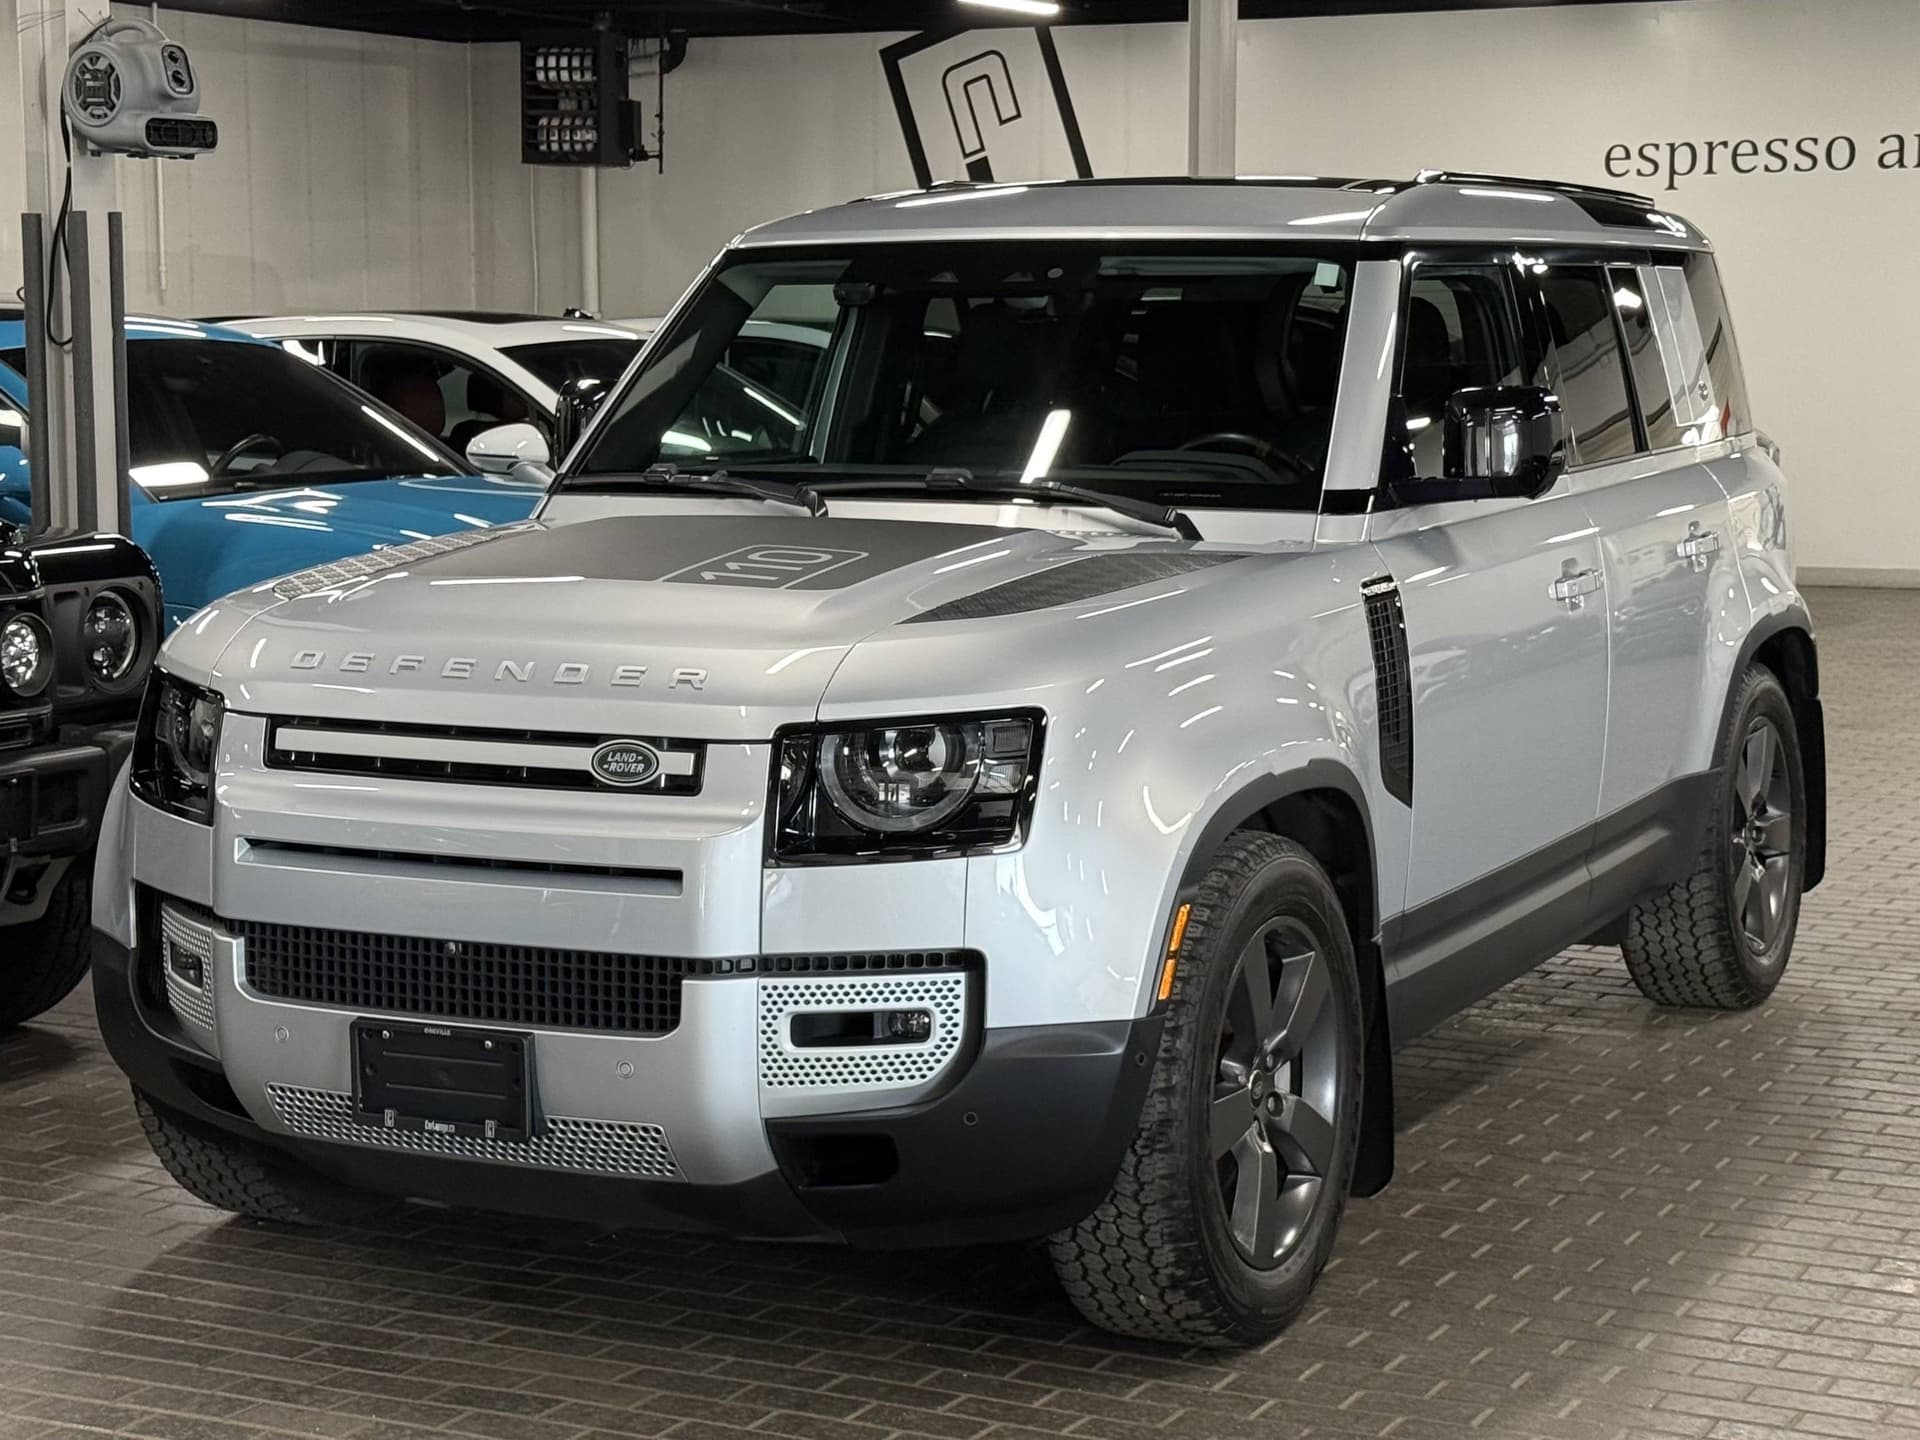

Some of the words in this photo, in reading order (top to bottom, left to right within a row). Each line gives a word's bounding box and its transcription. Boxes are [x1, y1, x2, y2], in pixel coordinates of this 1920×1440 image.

[1604, 136, 1856, 191] espresso
[700, 550, 833, 581] 110
[290, 649, 709, 690] DEFENDER
